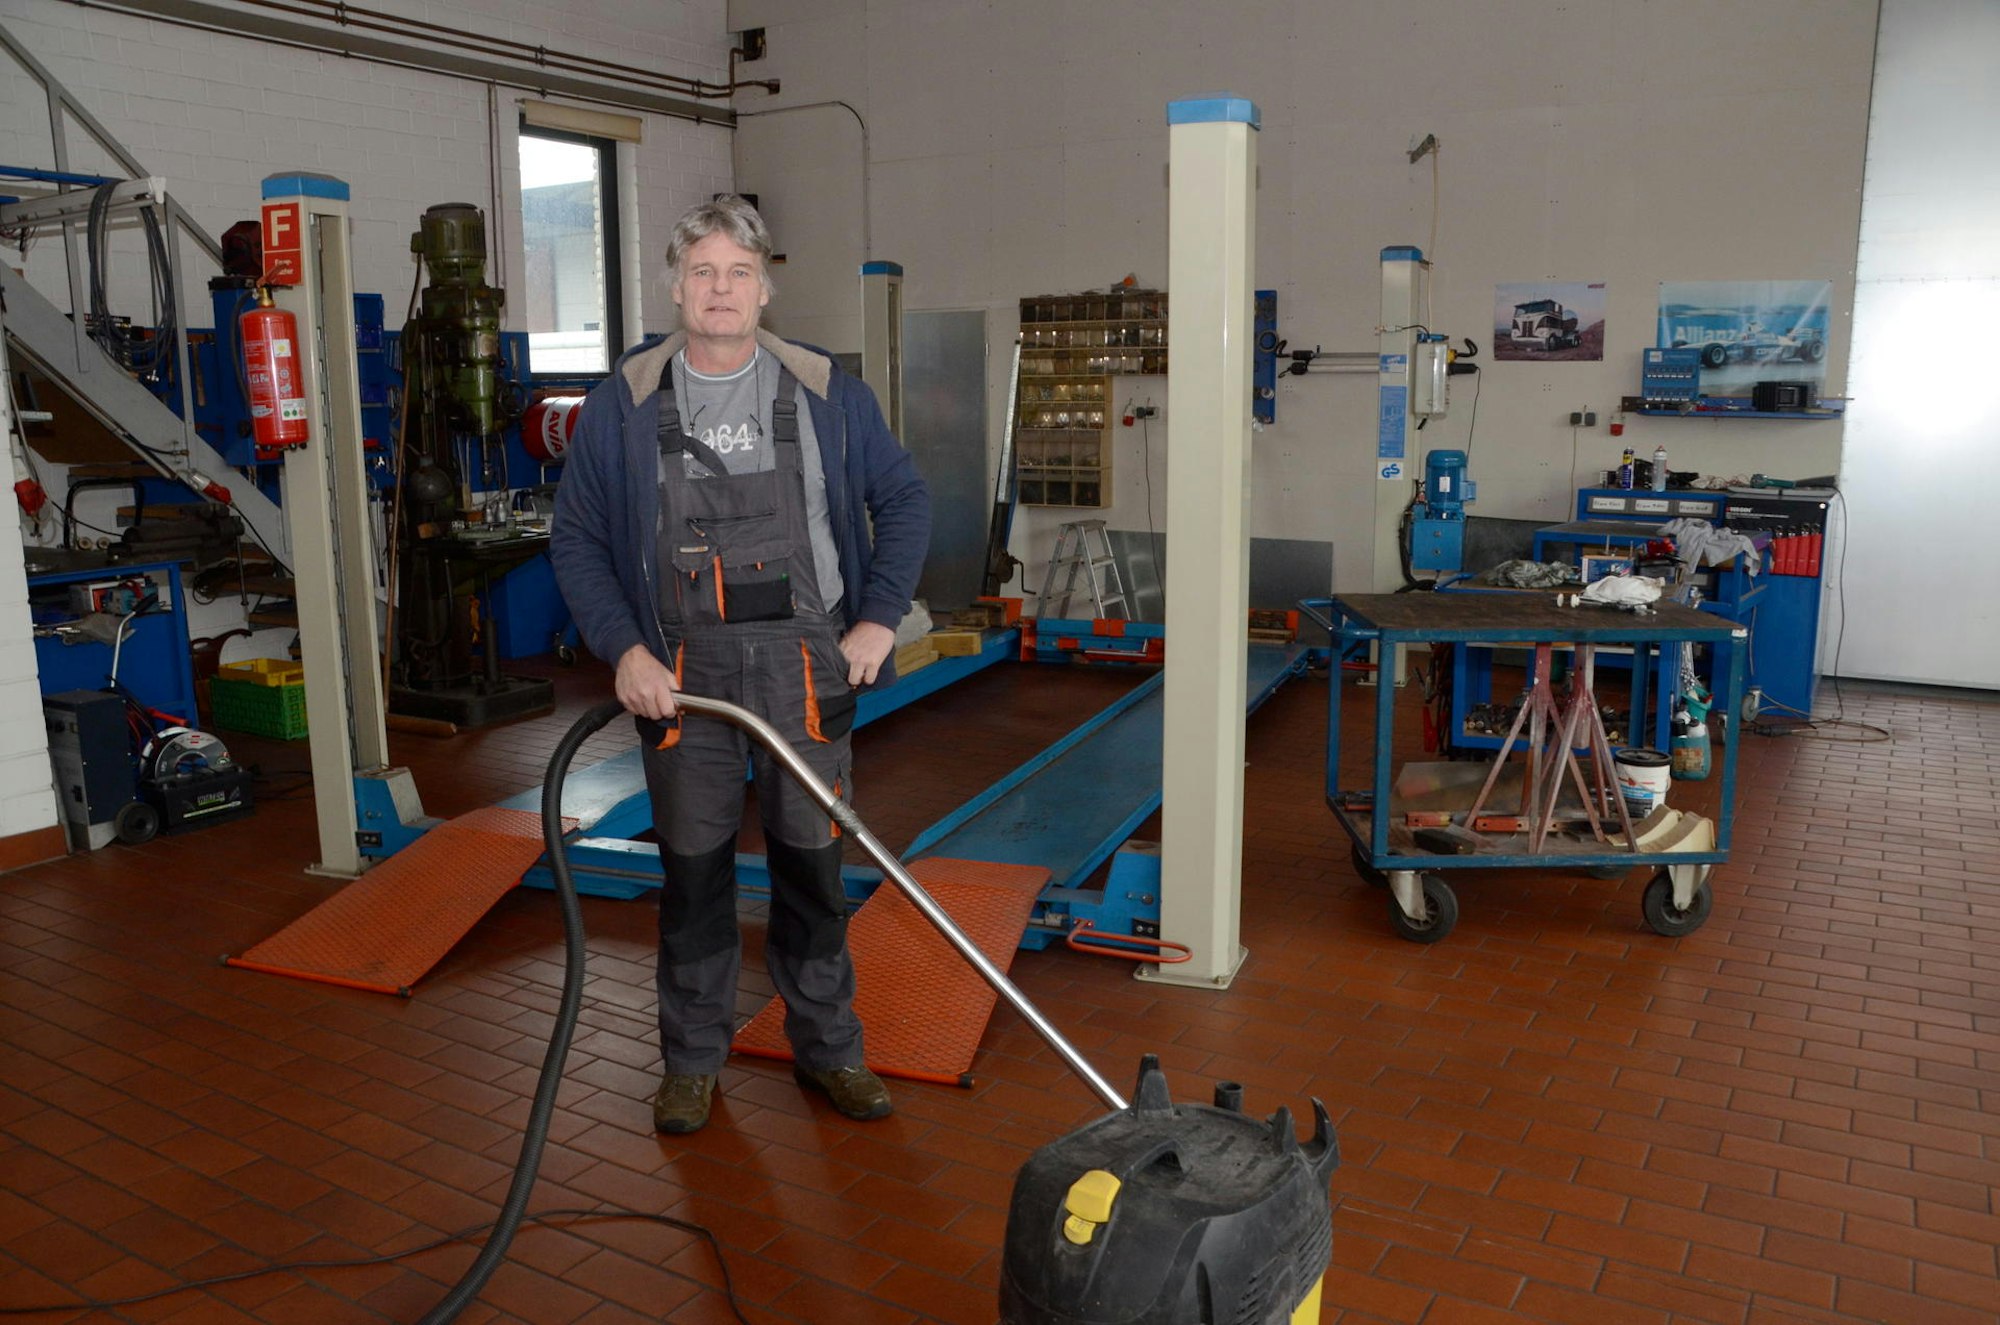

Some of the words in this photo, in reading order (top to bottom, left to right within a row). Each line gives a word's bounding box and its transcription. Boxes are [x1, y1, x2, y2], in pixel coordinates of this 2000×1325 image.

[270, 209, 292, 247] F
[1674, 326, 1738, 344] Allianz
[1381, 462, 1401, 479] GS
